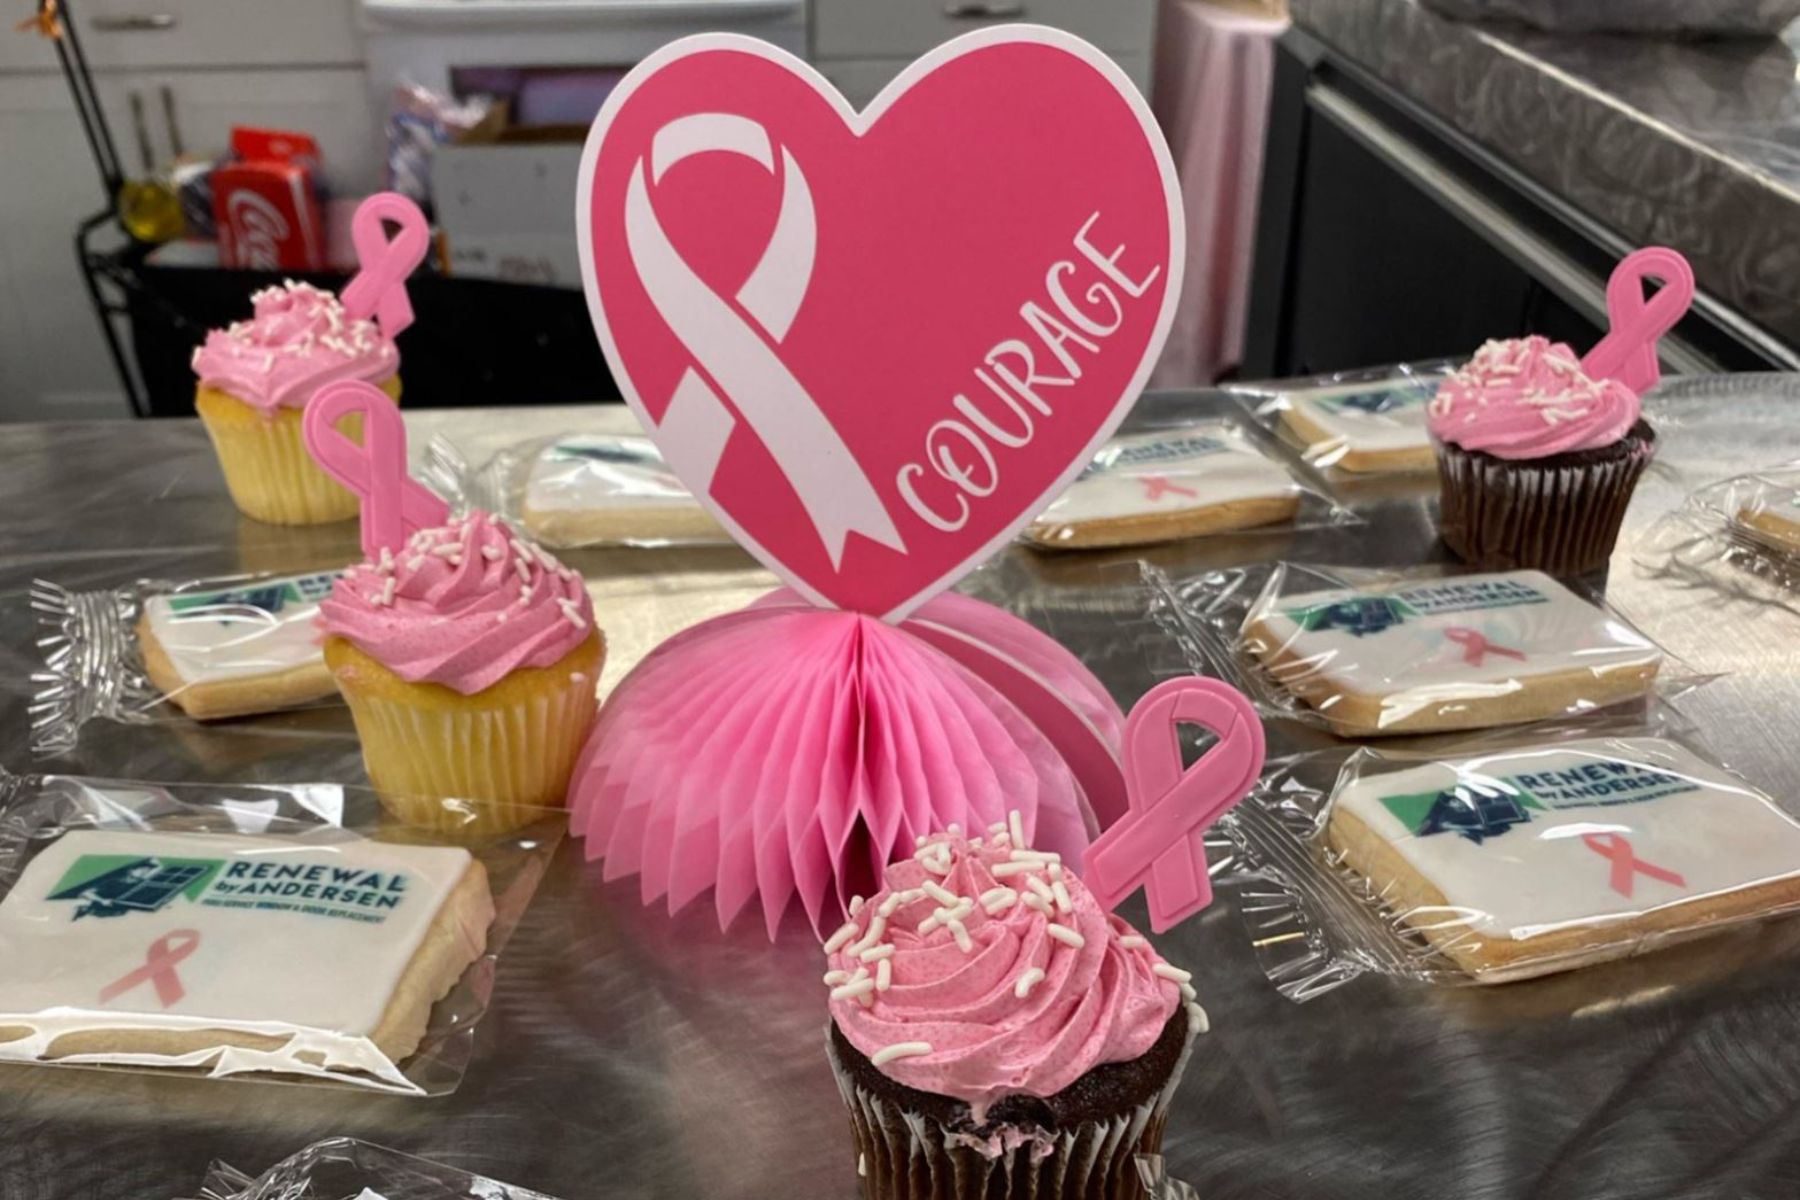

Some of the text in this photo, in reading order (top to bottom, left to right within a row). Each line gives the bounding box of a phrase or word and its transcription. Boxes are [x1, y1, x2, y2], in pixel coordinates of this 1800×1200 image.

[896, 211, 1161, 532] COURAGE
[226, 860, 407, 892] RENEWAL
[214, 880, 403, 909] by ANDERSEN
